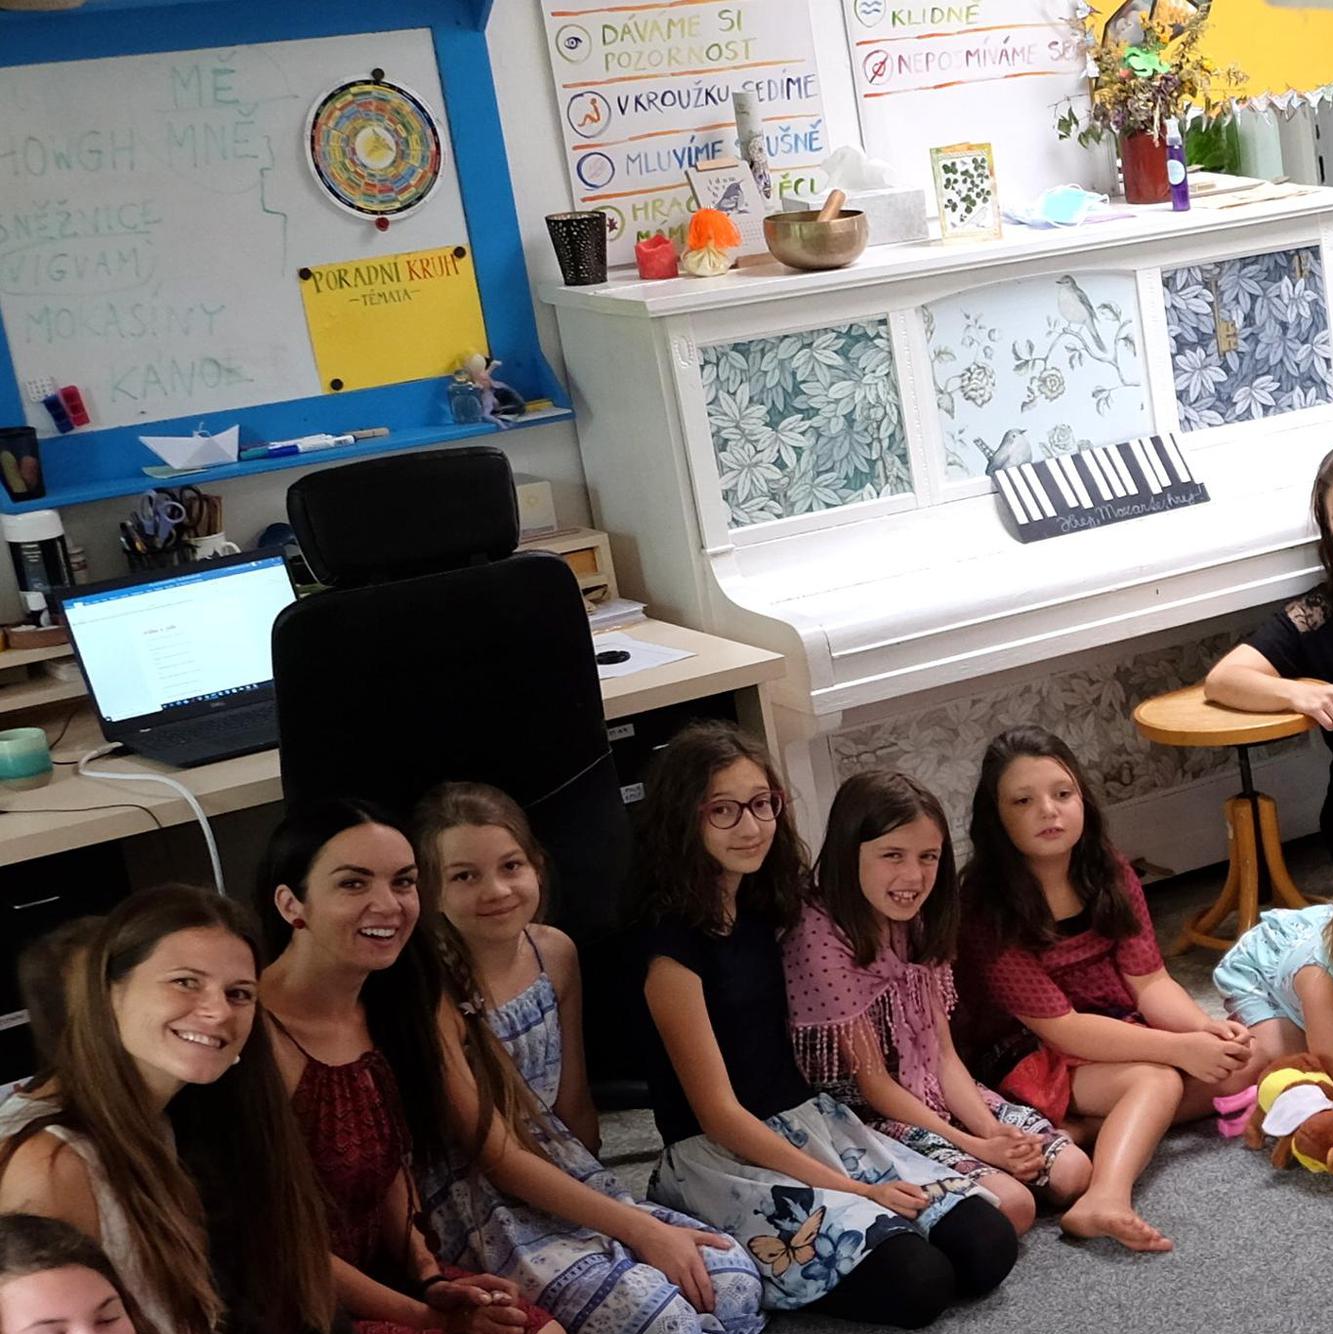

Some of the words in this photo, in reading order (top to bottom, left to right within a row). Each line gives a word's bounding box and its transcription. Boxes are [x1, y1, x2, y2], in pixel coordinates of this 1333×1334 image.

[601, 13, 701, 46] DÁVÁME
[718, 9, 743, 32] SI
[604, 37, 757, 72] POZORNOST
[406, 253, 459, 281] KRUH
